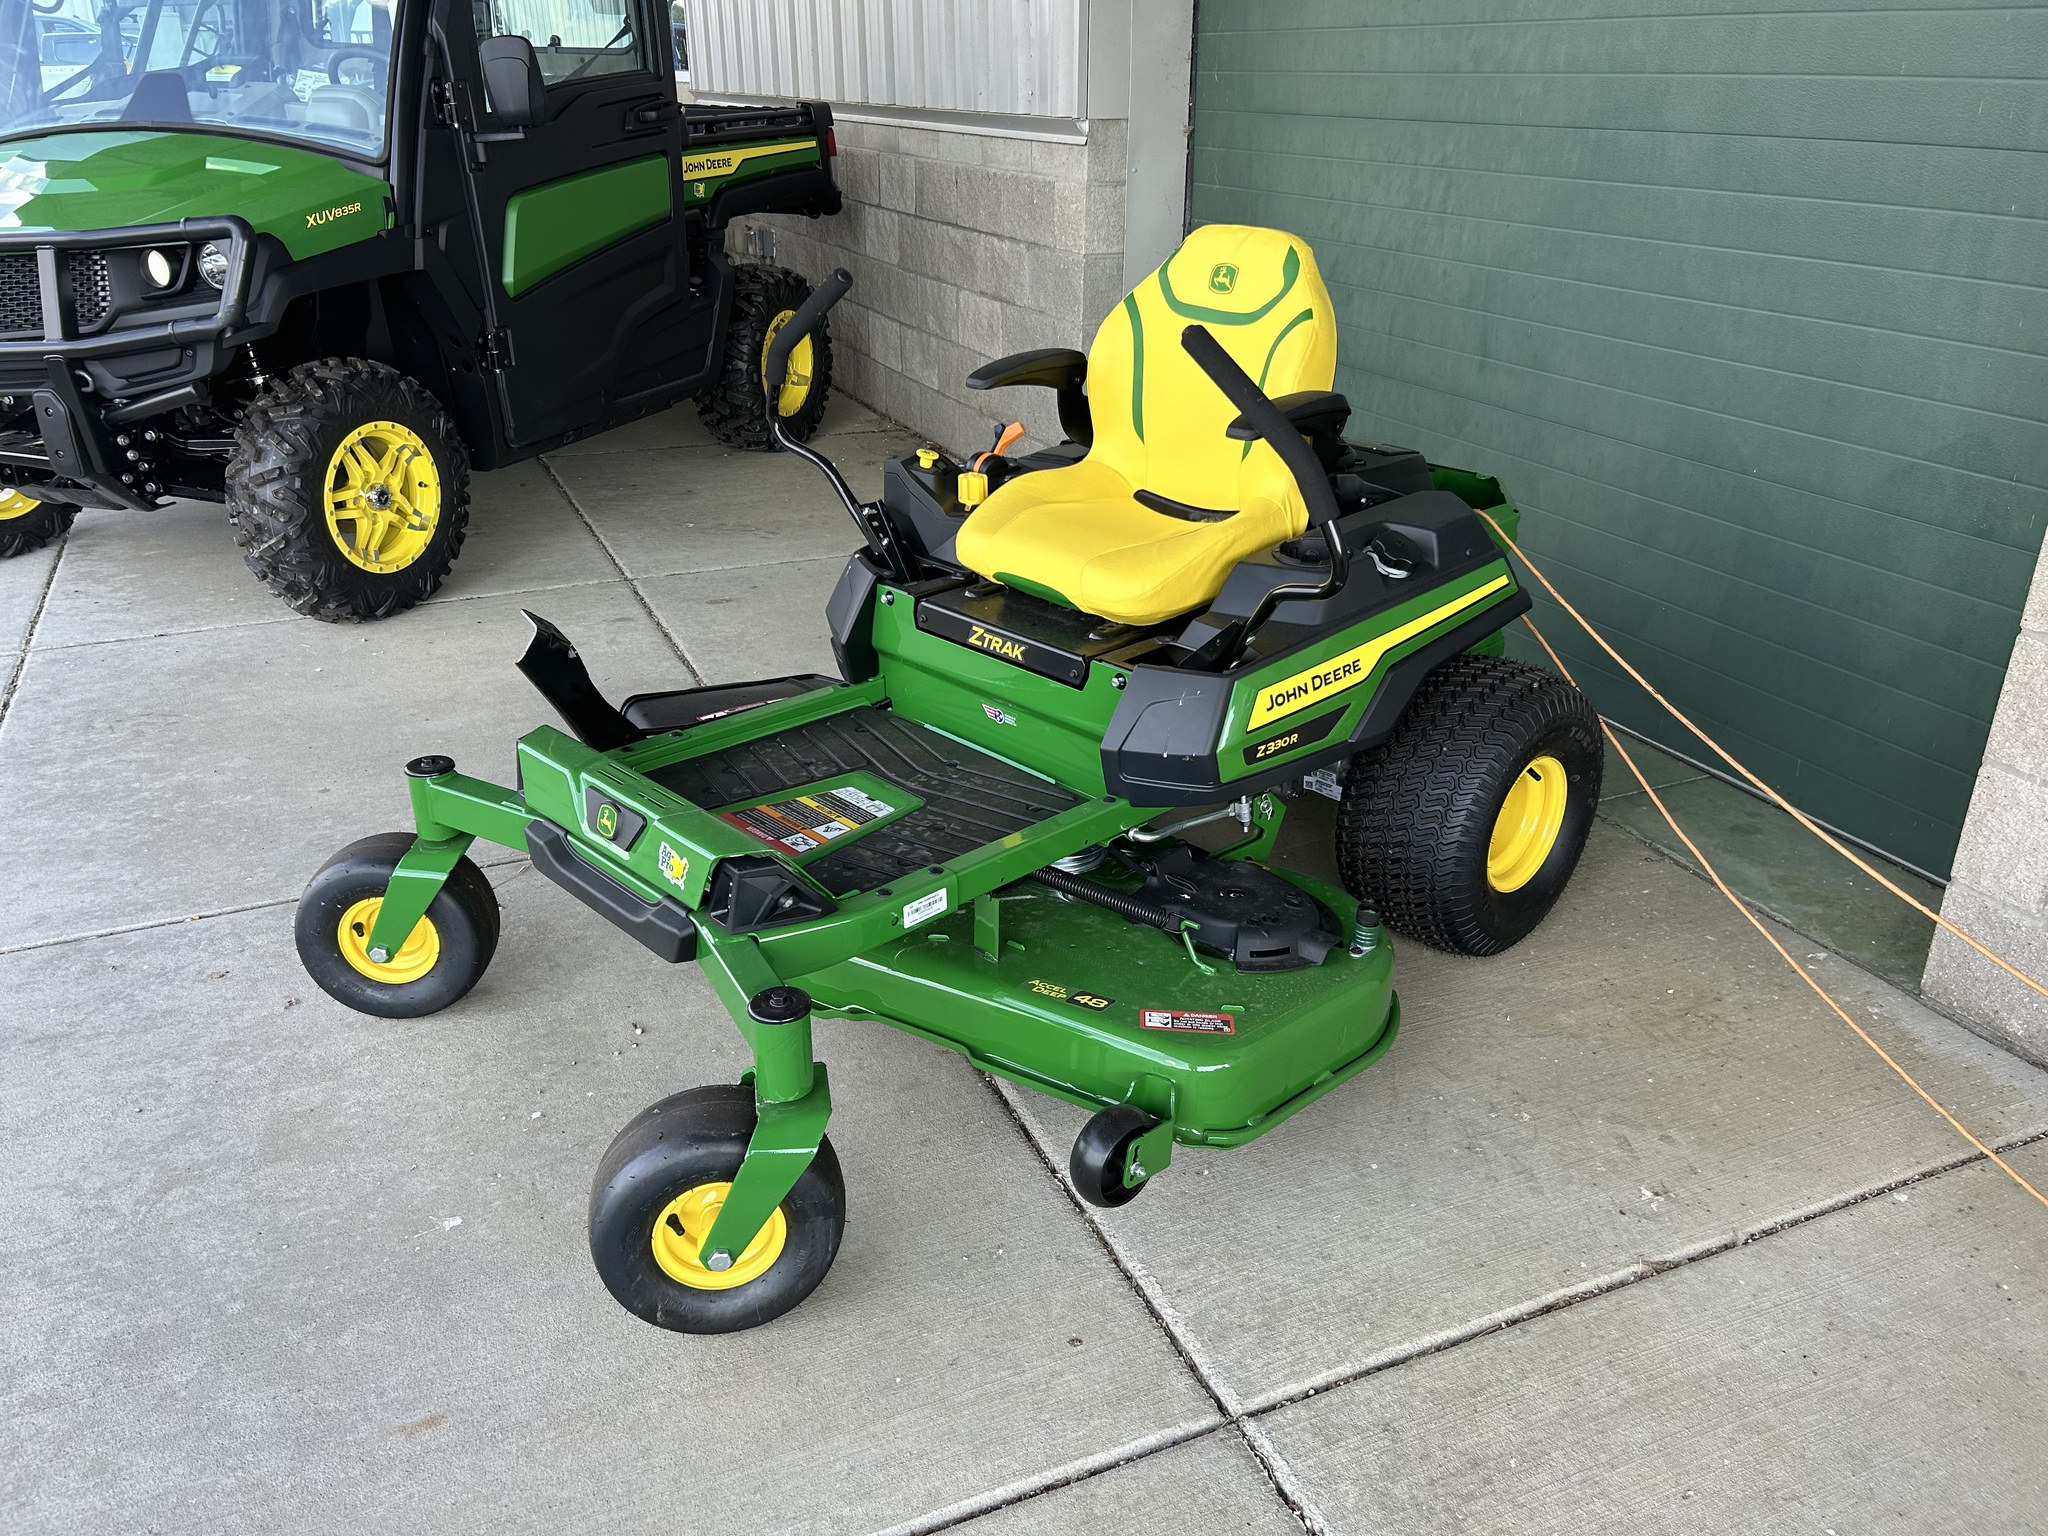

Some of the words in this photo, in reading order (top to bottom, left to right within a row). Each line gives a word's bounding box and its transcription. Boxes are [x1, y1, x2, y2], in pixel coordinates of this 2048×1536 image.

[684, 161, 705, 173] JOHN
[706, 158, 732, 170] DEERE
[305, 202, 361, 229] XUV835R
[968, 625, 1026, 661] ZTRAK
[1266, 682, 1309, 712] JOHN
[1311, 658, 1362, 692] DEERE
[1256, 733, 1299, 759] Z330R
[1027, 979, 1067, 994] ACCEL
[1031, 986, 1068, 999] DEEP
[1073, 995, 1109, 1009] 48
